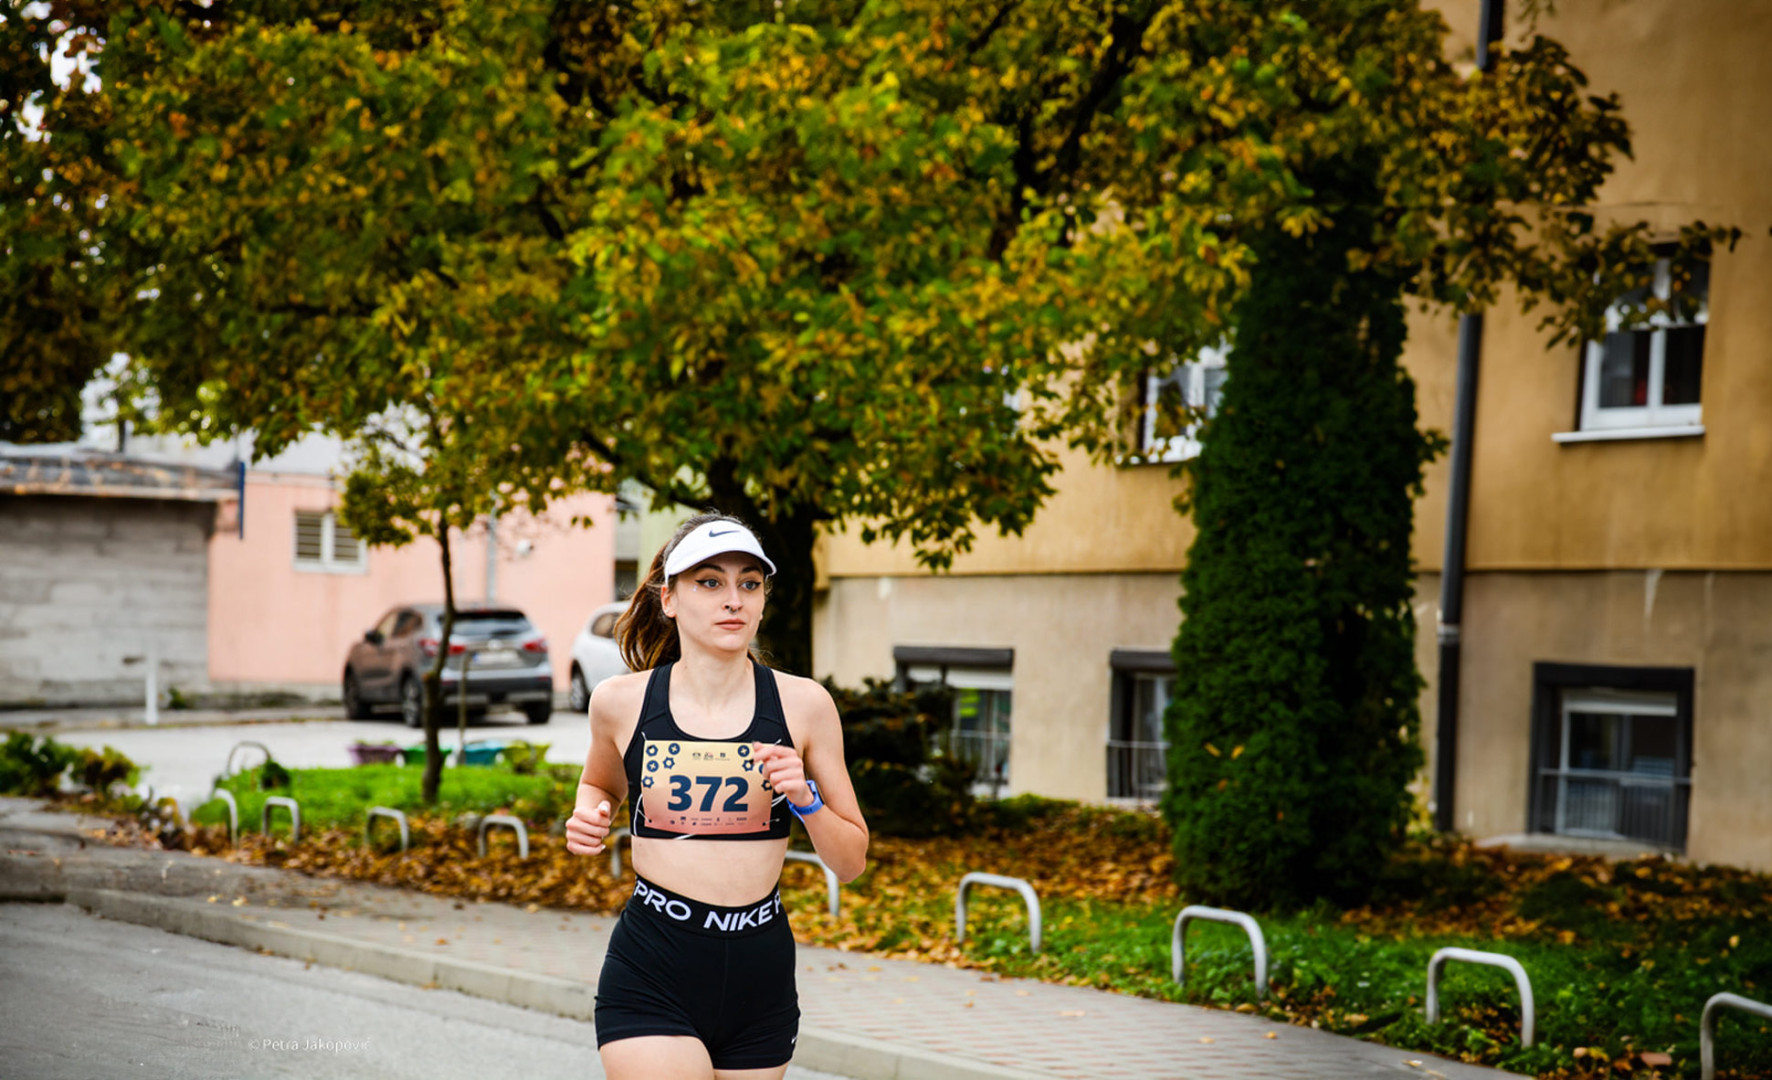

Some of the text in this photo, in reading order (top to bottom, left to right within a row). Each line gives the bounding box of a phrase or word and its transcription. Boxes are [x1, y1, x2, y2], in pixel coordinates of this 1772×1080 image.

[668, 775, 749, 812] 372
[633, 880, 692, 921] PRO
[703, 901, 773, 932] NIKE
